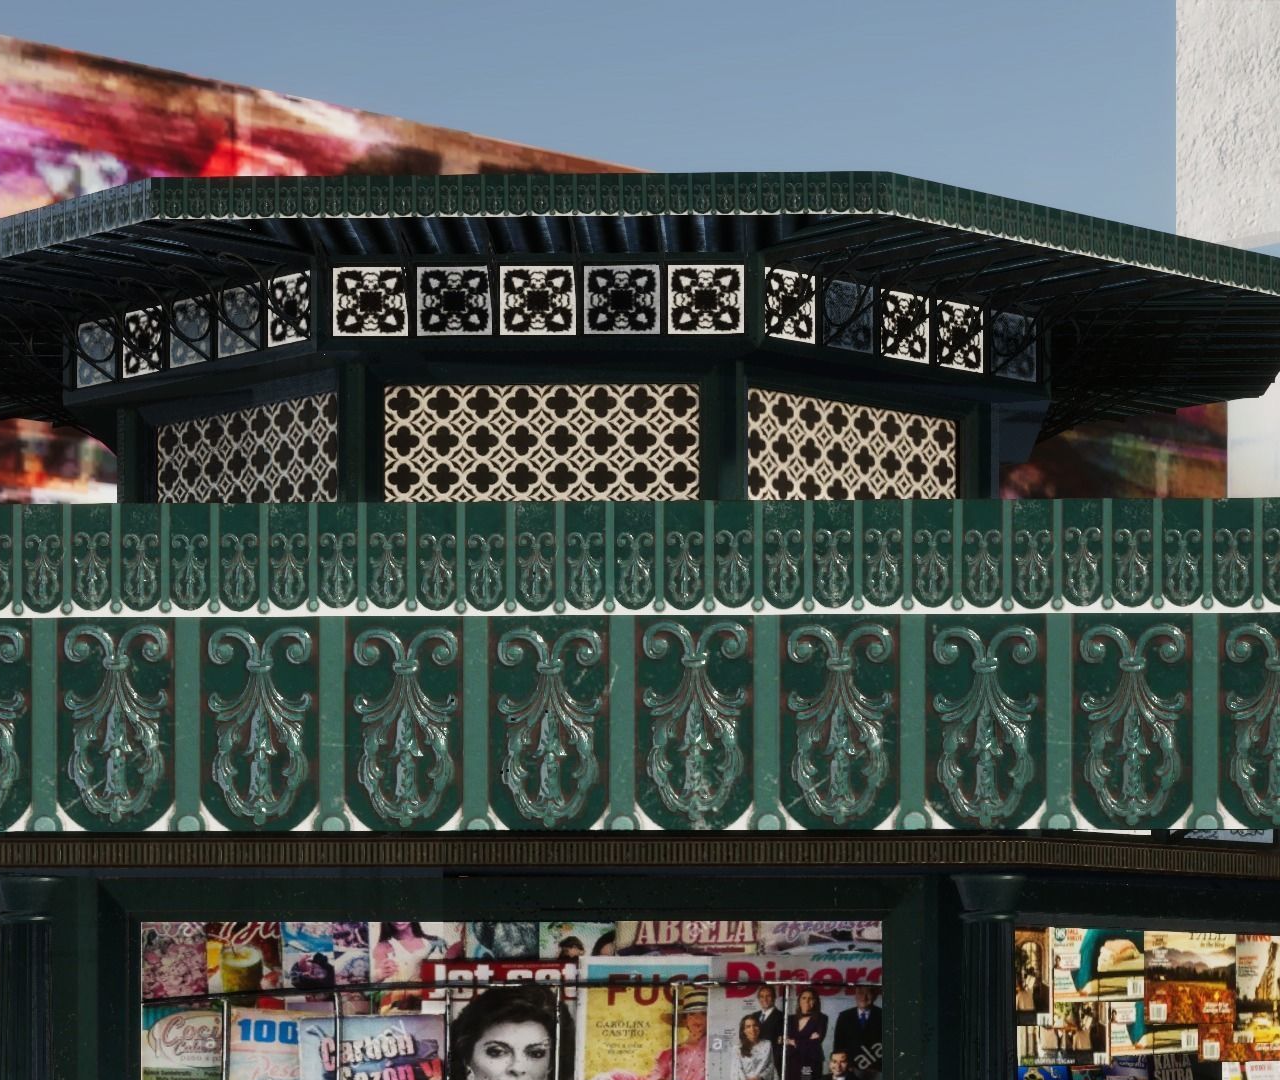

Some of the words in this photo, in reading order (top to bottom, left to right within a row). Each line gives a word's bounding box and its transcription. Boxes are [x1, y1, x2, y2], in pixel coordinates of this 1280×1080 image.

[428, 964, 495, 999] Jet
[237, 1018, 299, 1044] 100
[595, 1020, 651, 1029] CAROLINA
[602, 1029, 645, 1038] CASTRO
